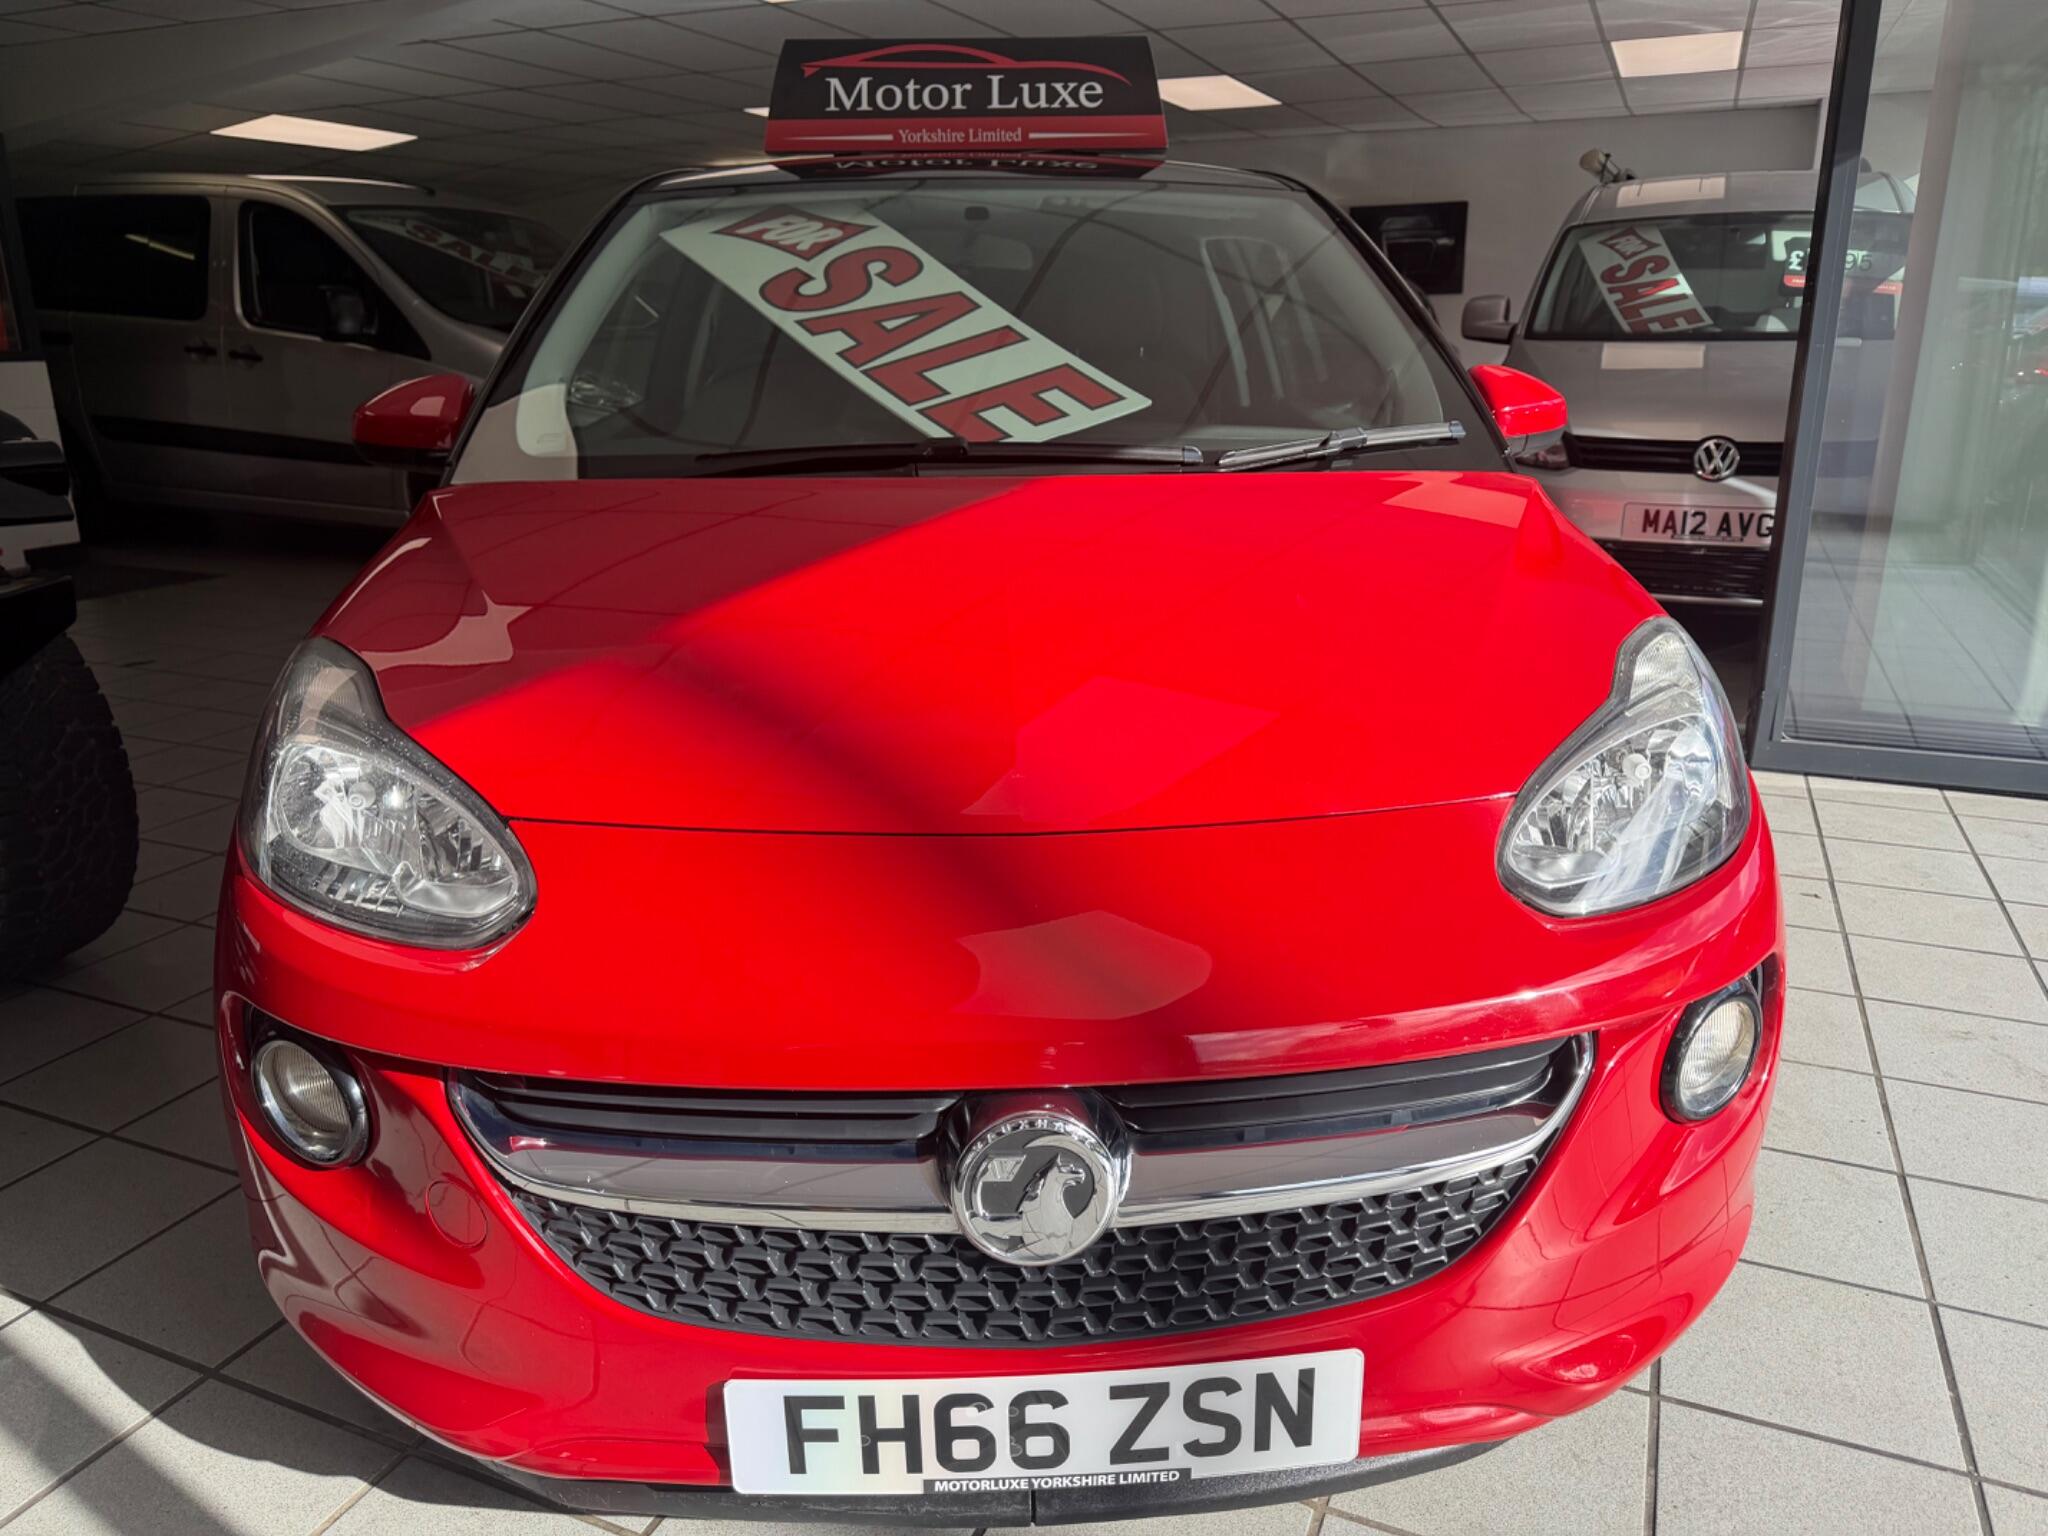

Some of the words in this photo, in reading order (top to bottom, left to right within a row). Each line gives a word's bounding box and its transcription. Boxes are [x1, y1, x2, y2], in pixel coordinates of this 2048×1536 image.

[825, 76, 972, 112] Motor
[986, 74, 1104, 109] Luxe
[899, 129, 965, 144] Yorkshire
[968, 127, 1022, 143] Limited
[735, 213, 844, 252] FOR
[1600, 254, 1706, 334] SALE
[758, 245, 1127, 443] SALE
[1716, 511, 1775, 538] AVG
[783, 1388, 1071, 1475] FH66
[1109, 1367, 1316, 1466] ZSN
[934, 1478, 1029, 1492] MOTORLUXE
[1031, 1473, 1116, 1490] YORKSHIRE
[1119, 1470, 1180, 1485] LIMITED
